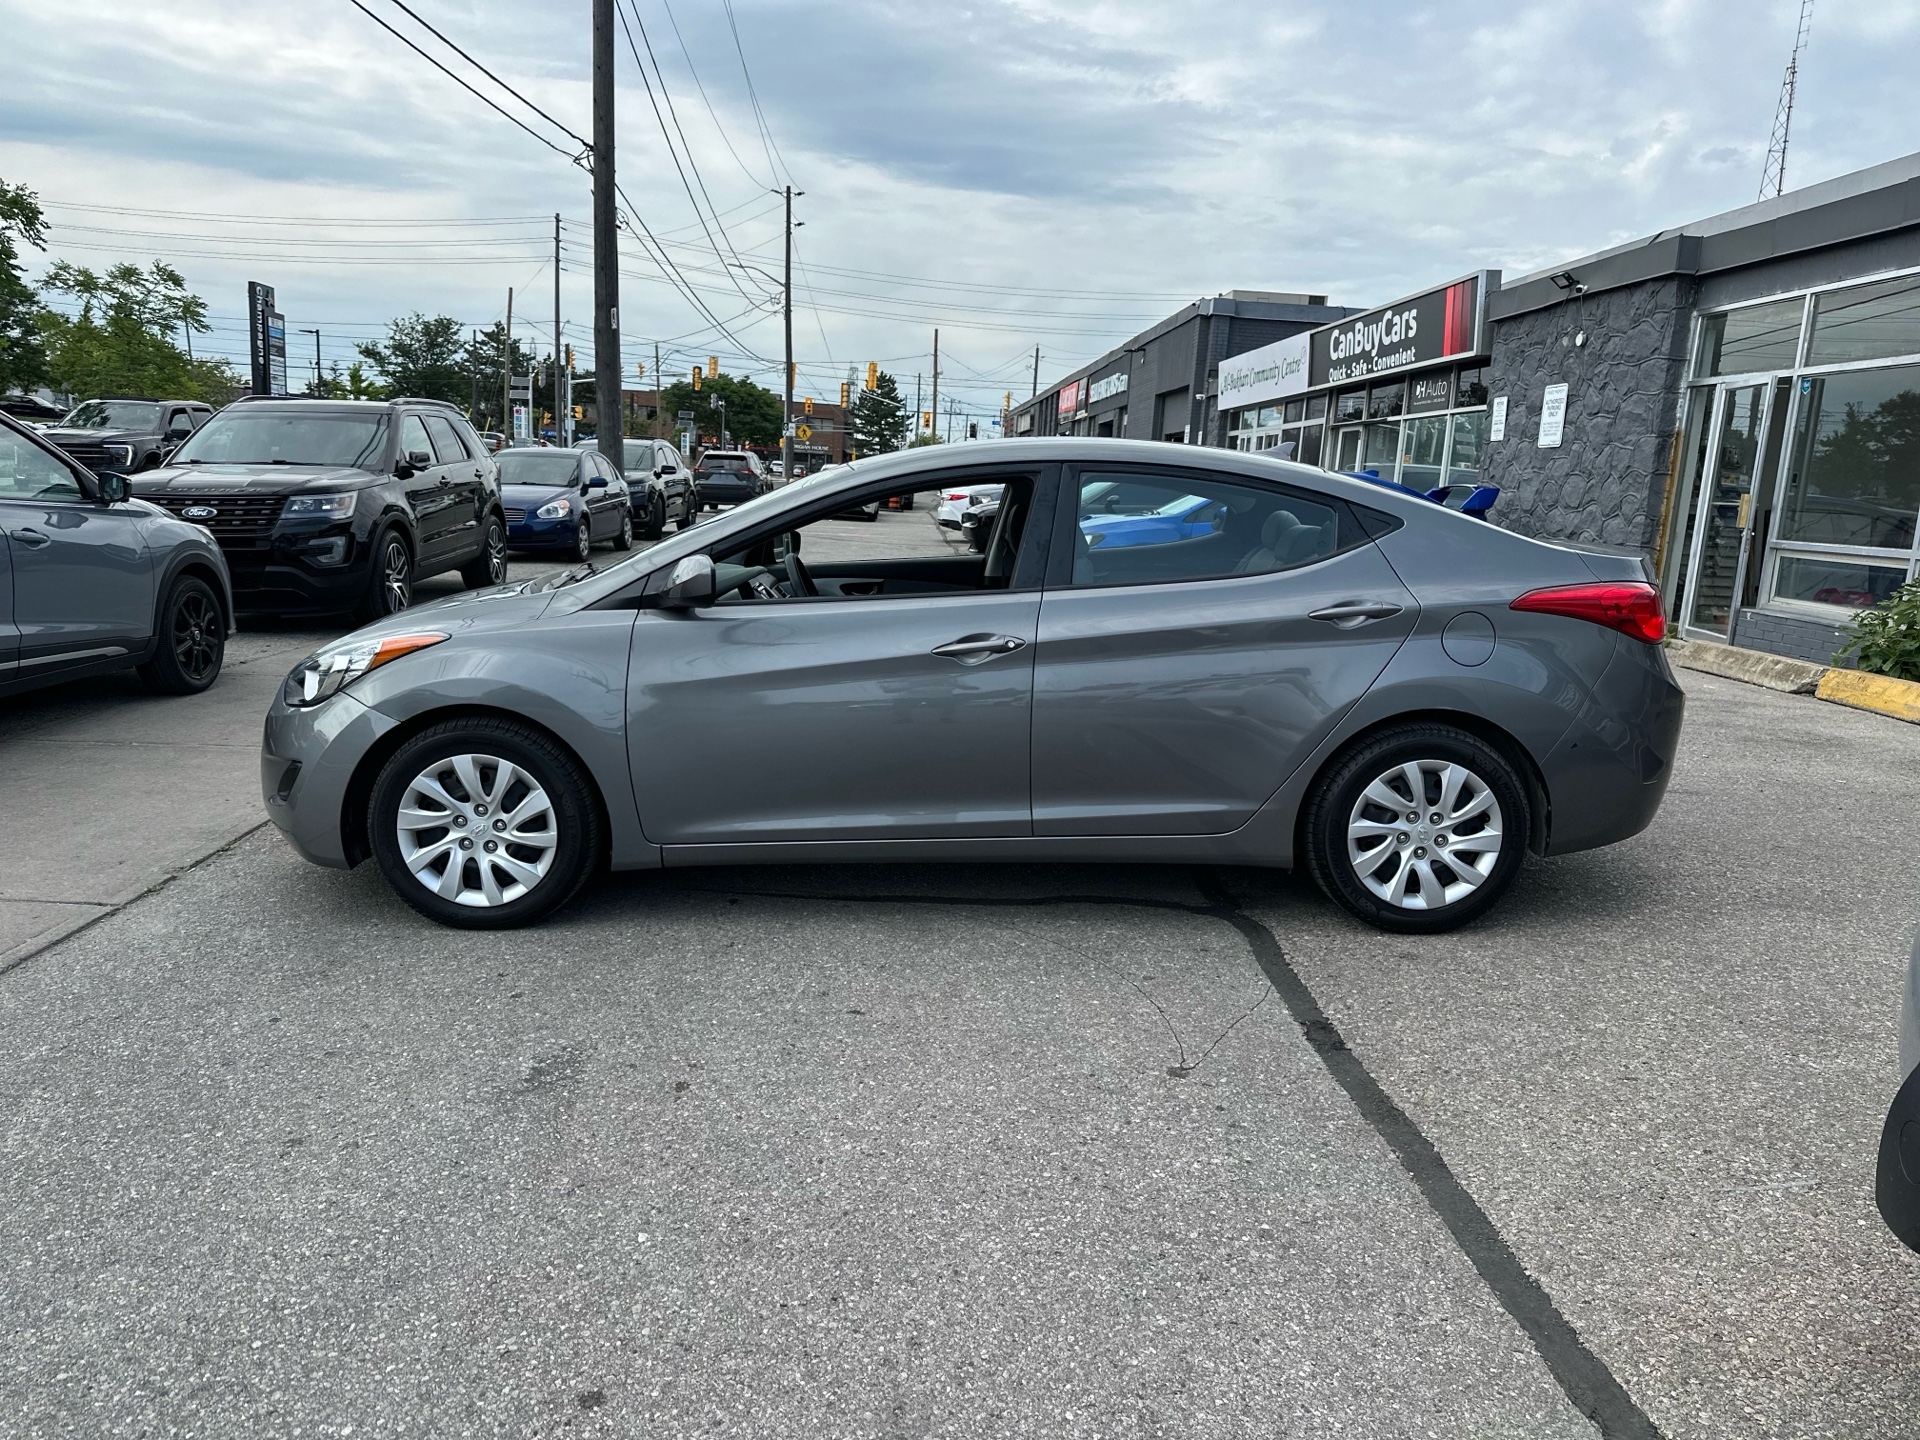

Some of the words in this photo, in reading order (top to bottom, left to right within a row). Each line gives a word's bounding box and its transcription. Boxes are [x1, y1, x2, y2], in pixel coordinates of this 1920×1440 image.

[1329, 308, 1417, 361] CanBuyCars
[1250, 360, 1281, 387] Community
[1281, 357, 1302, 379] Centre
[1328, 363, 1346, 383] Quick
[1351, 359, 1367, 377] Safe
[1373, 346, 1416, 371] Convenient
[1425, 379, 1447, 397] Auto
[188, 508, 209, 516] Ford
